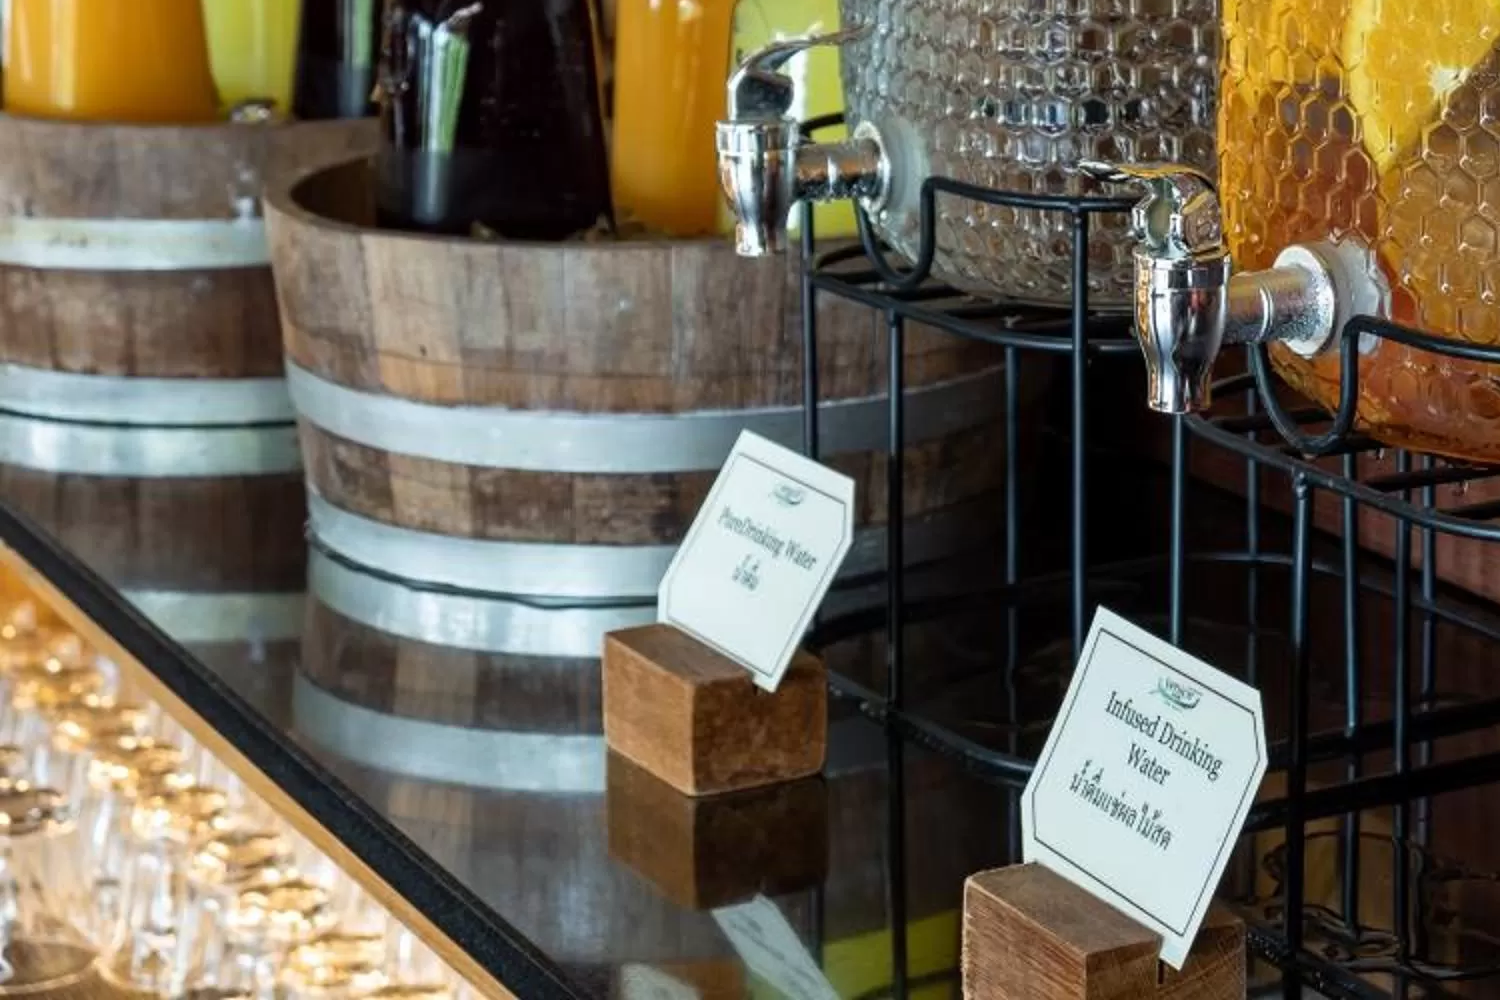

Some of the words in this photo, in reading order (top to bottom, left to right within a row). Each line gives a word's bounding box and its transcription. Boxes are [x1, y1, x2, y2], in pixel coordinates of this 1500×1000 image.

[785, 538, 817, 571] Water
[1105, 690, 1161, 738] Infused
[1158, 720, 1224, 782] Drinking
[1127, 743, 1172, 785] Water
